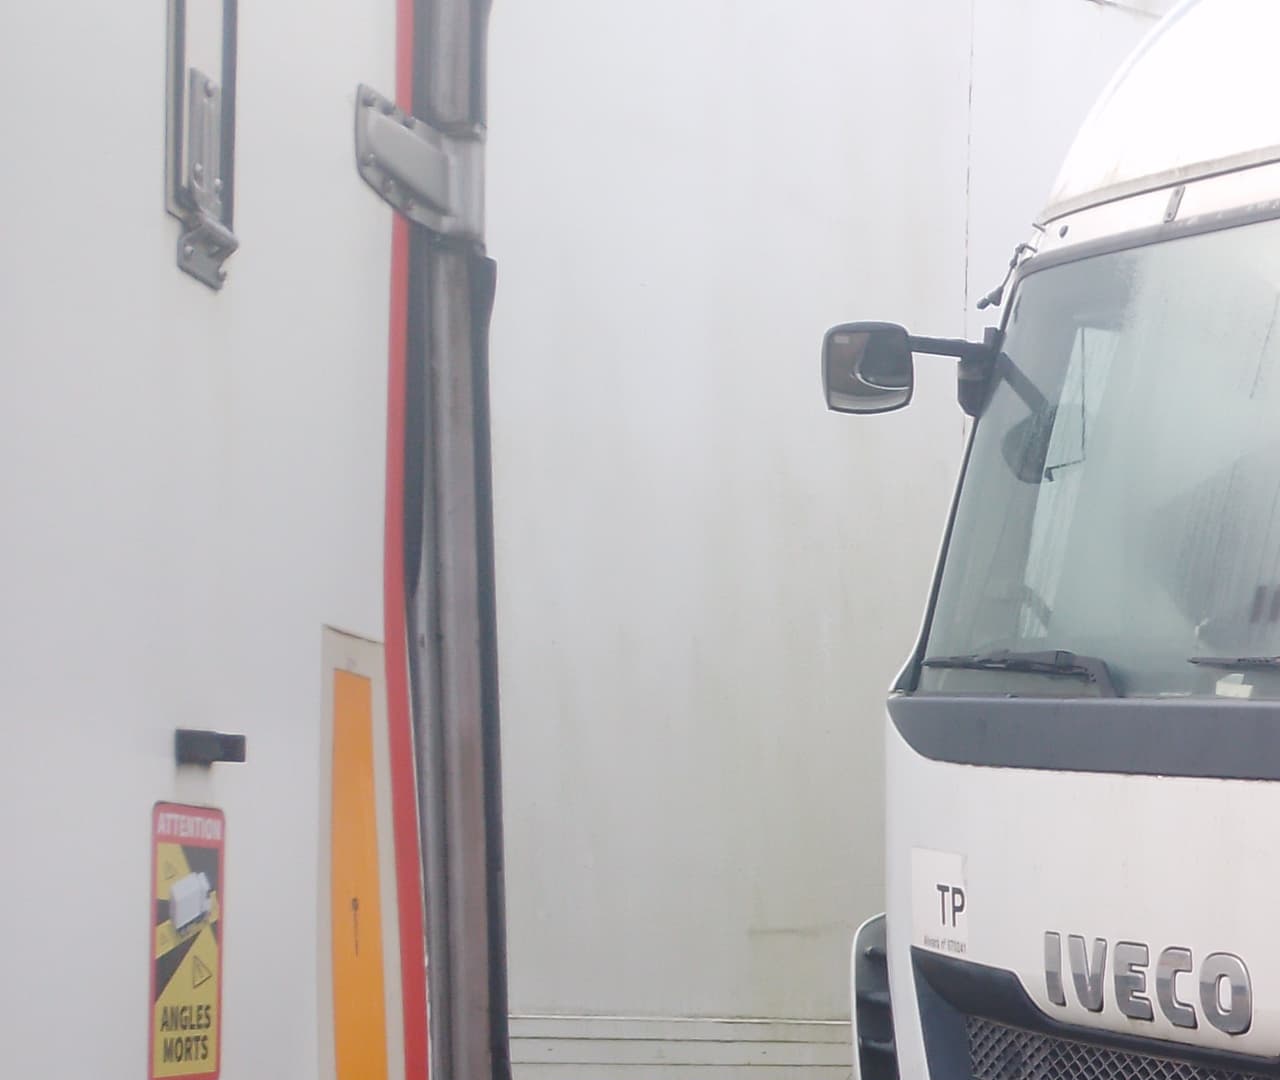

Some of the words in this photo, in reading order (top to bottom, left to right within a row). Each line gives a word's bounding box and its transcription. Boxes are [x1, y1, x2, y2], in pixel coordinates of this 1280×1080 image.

[157, 812, 222, 840] ATTENTION
[936, 884, 965, 928] TP
[1044, 931, 1253, 1036] IVECO
[160, 1005, 211, 1032] ANGLES
[163, 1036, 209, 1063] MORTS
